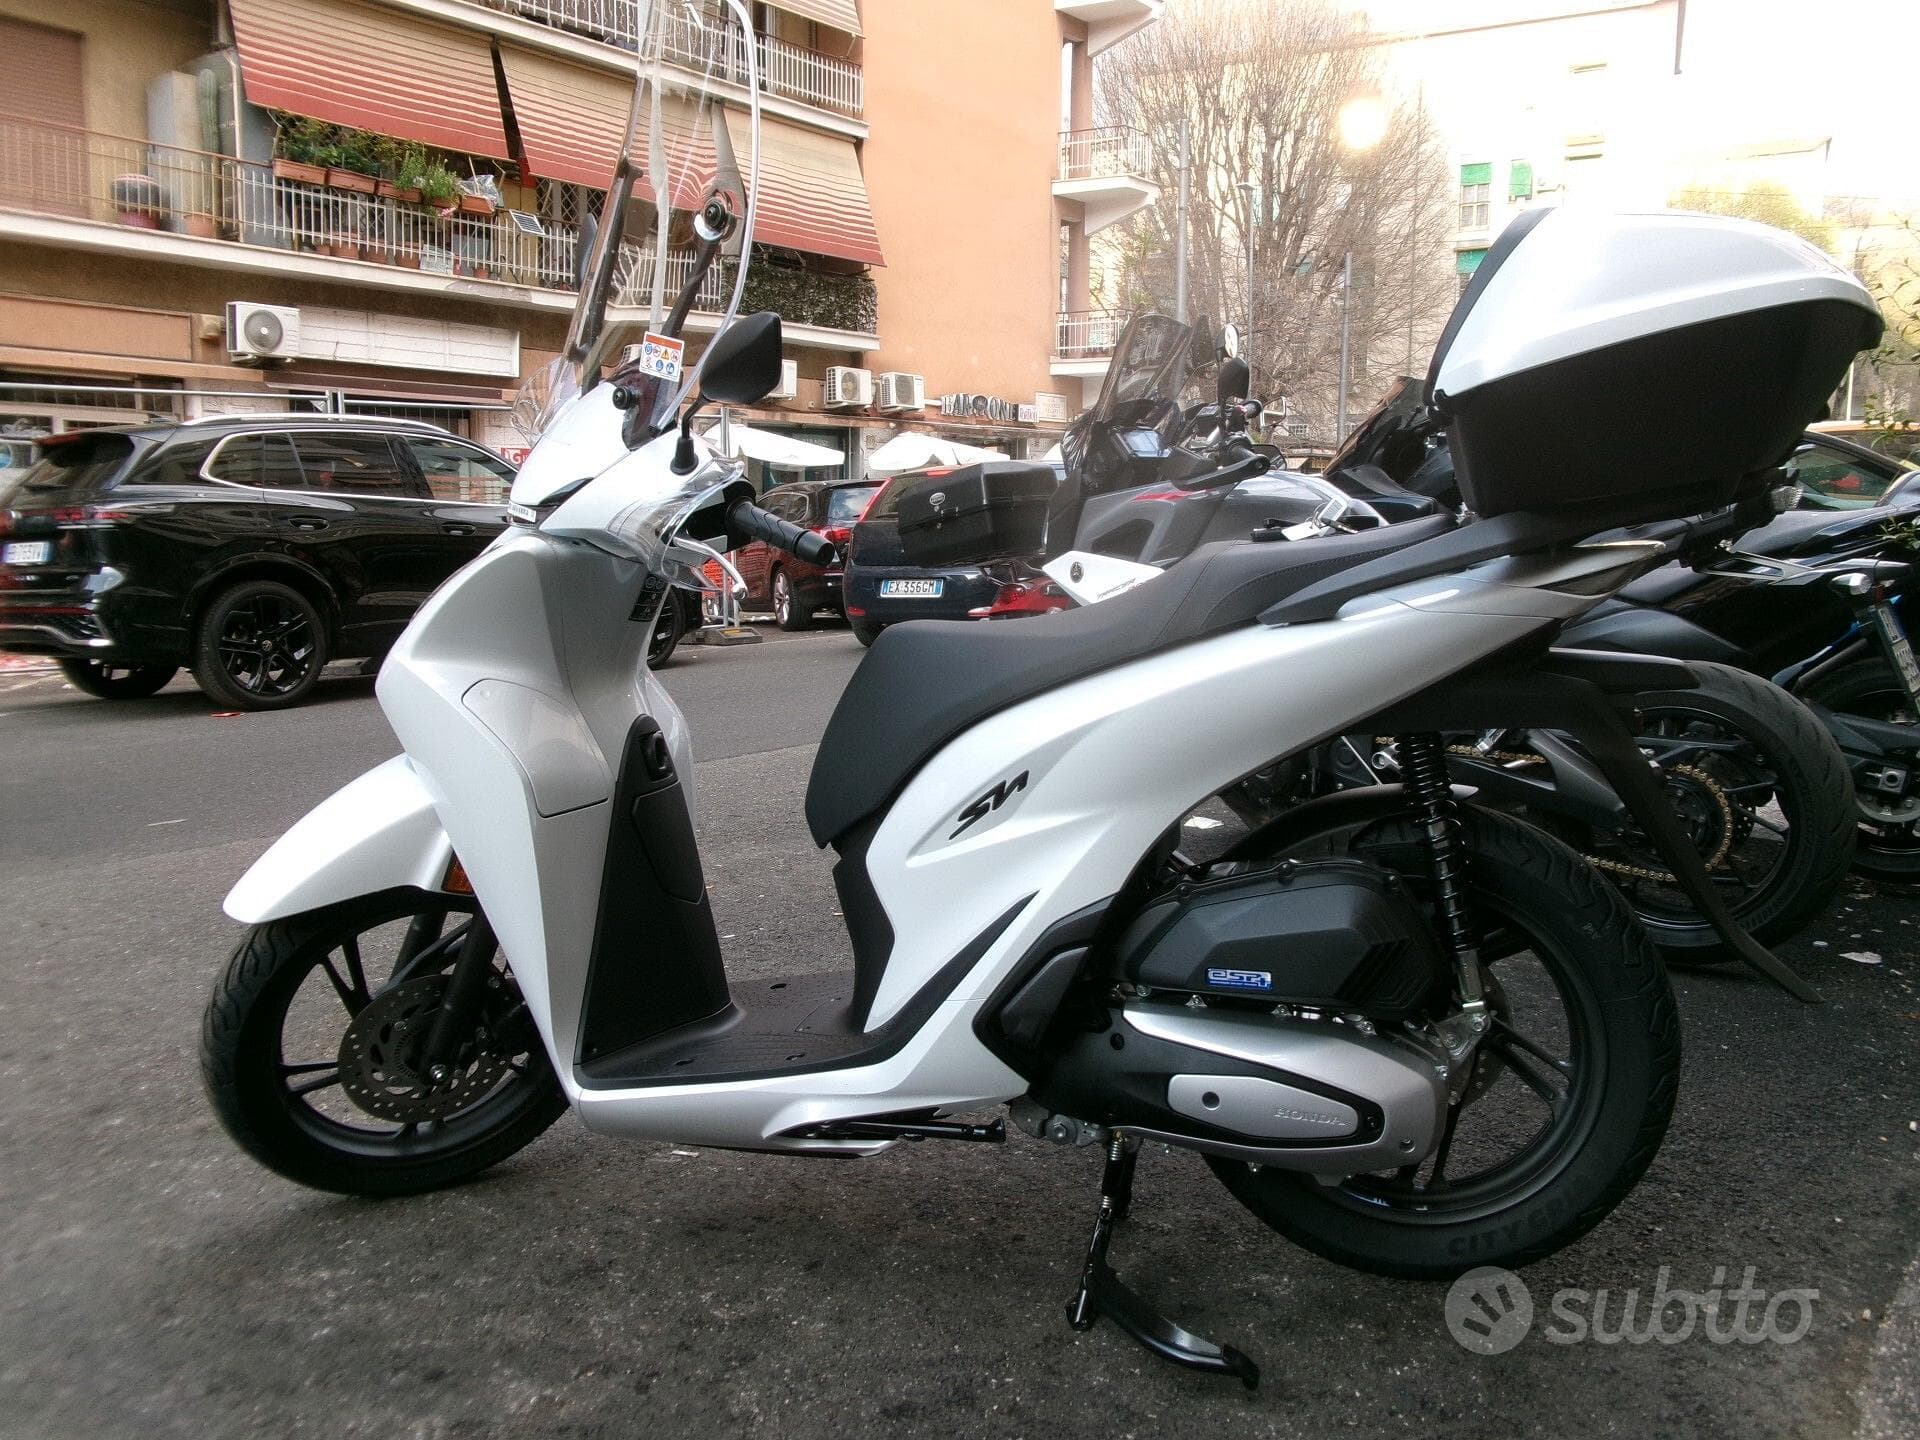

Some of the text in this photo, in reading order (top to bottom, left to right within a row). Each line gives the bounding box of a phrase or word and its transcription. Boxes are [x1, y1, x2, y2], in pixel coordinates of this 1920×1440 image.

[889, 581, 900, 593] EX
[1273, 1104, 1350, 1127] HONDA
[1448, 1219, 1520, 1257] CITY
